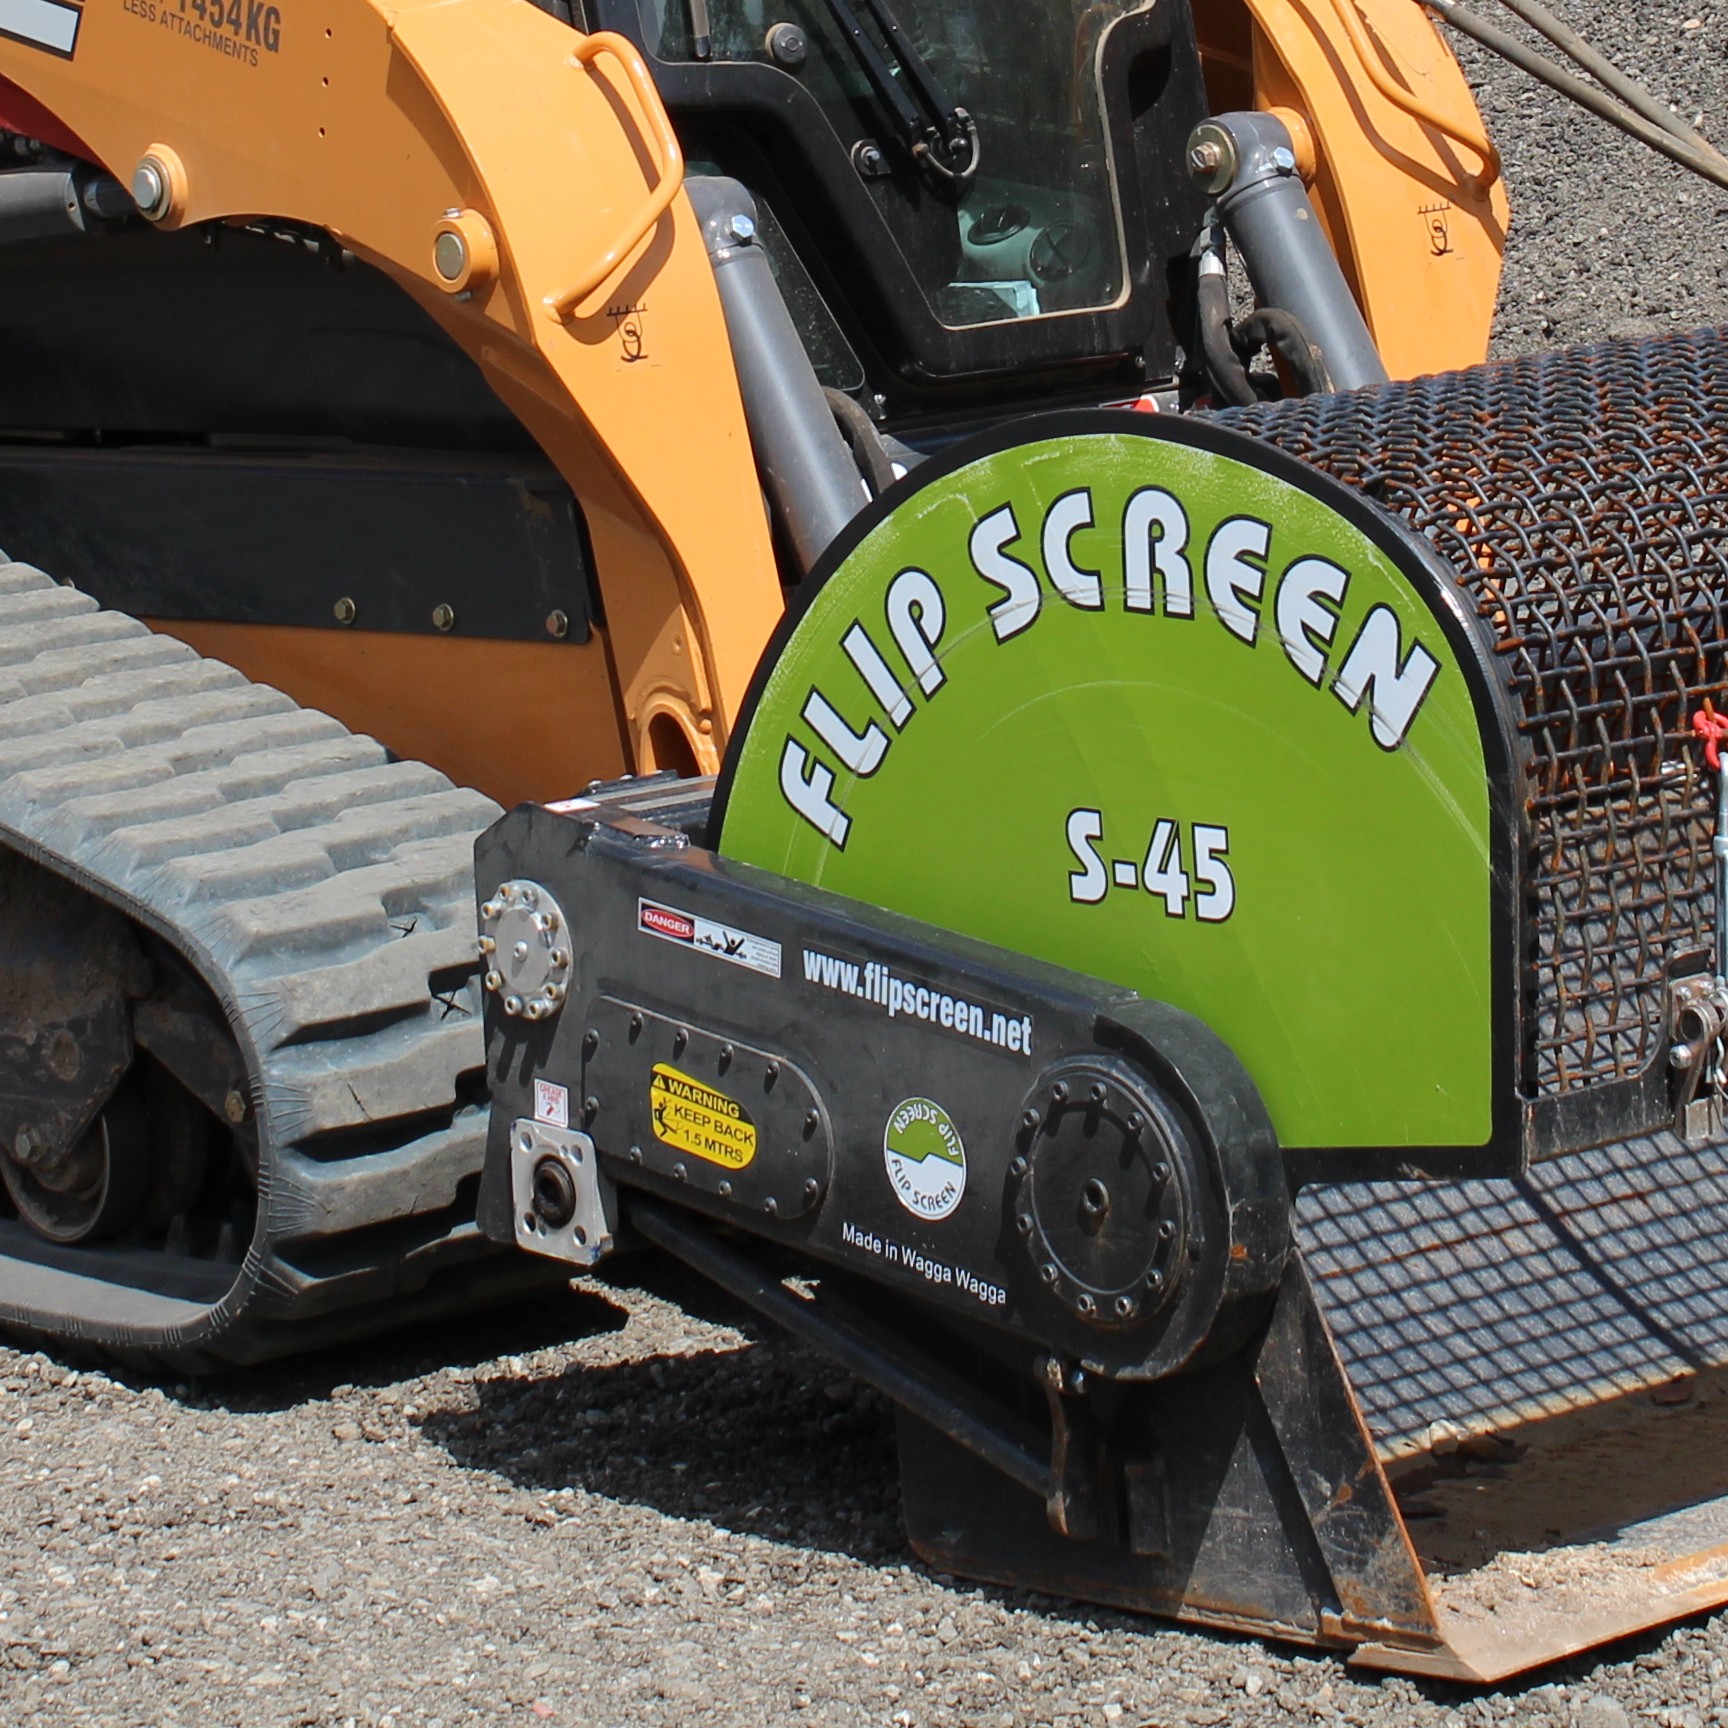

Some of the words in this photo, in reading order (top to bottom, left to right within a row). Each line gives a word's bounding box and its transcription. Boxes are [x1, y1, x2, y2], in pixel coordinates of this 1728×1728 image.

[160, 10, 259, 67] ATTACHMENTS
[779, 567, 947, 852] FLIP
[967, 484, 1443, 753] SCREEN
[1066, 807, 1236, 923] S-45
[644, 912, 691, 934] DANGER
[803, 949, 1032, 1056] www.flipscreen.net
[668, 1078, 740, 1118] WARNING
[893, 1103, 938, 1135] SCREEN
[674, 1104, 711, 1128] KEEP
[714, 1119, 754, 1147] BACK
[684, 1129, 702, 1146] 1.5
[705, 1137, 743, 1163] MTRS
[938, 1123, 960, 1157] FLIP
[892, 1159, 911, 1191] FLIP
[912, 1180, 957, 1212] SCREEN
[842, 1222, 881, 1254] Made
[885, 1239, 898, 1261] in
[901, 1245, 952, 1284] Wagga
[955, 1267, 1006, 1305] Wagga
